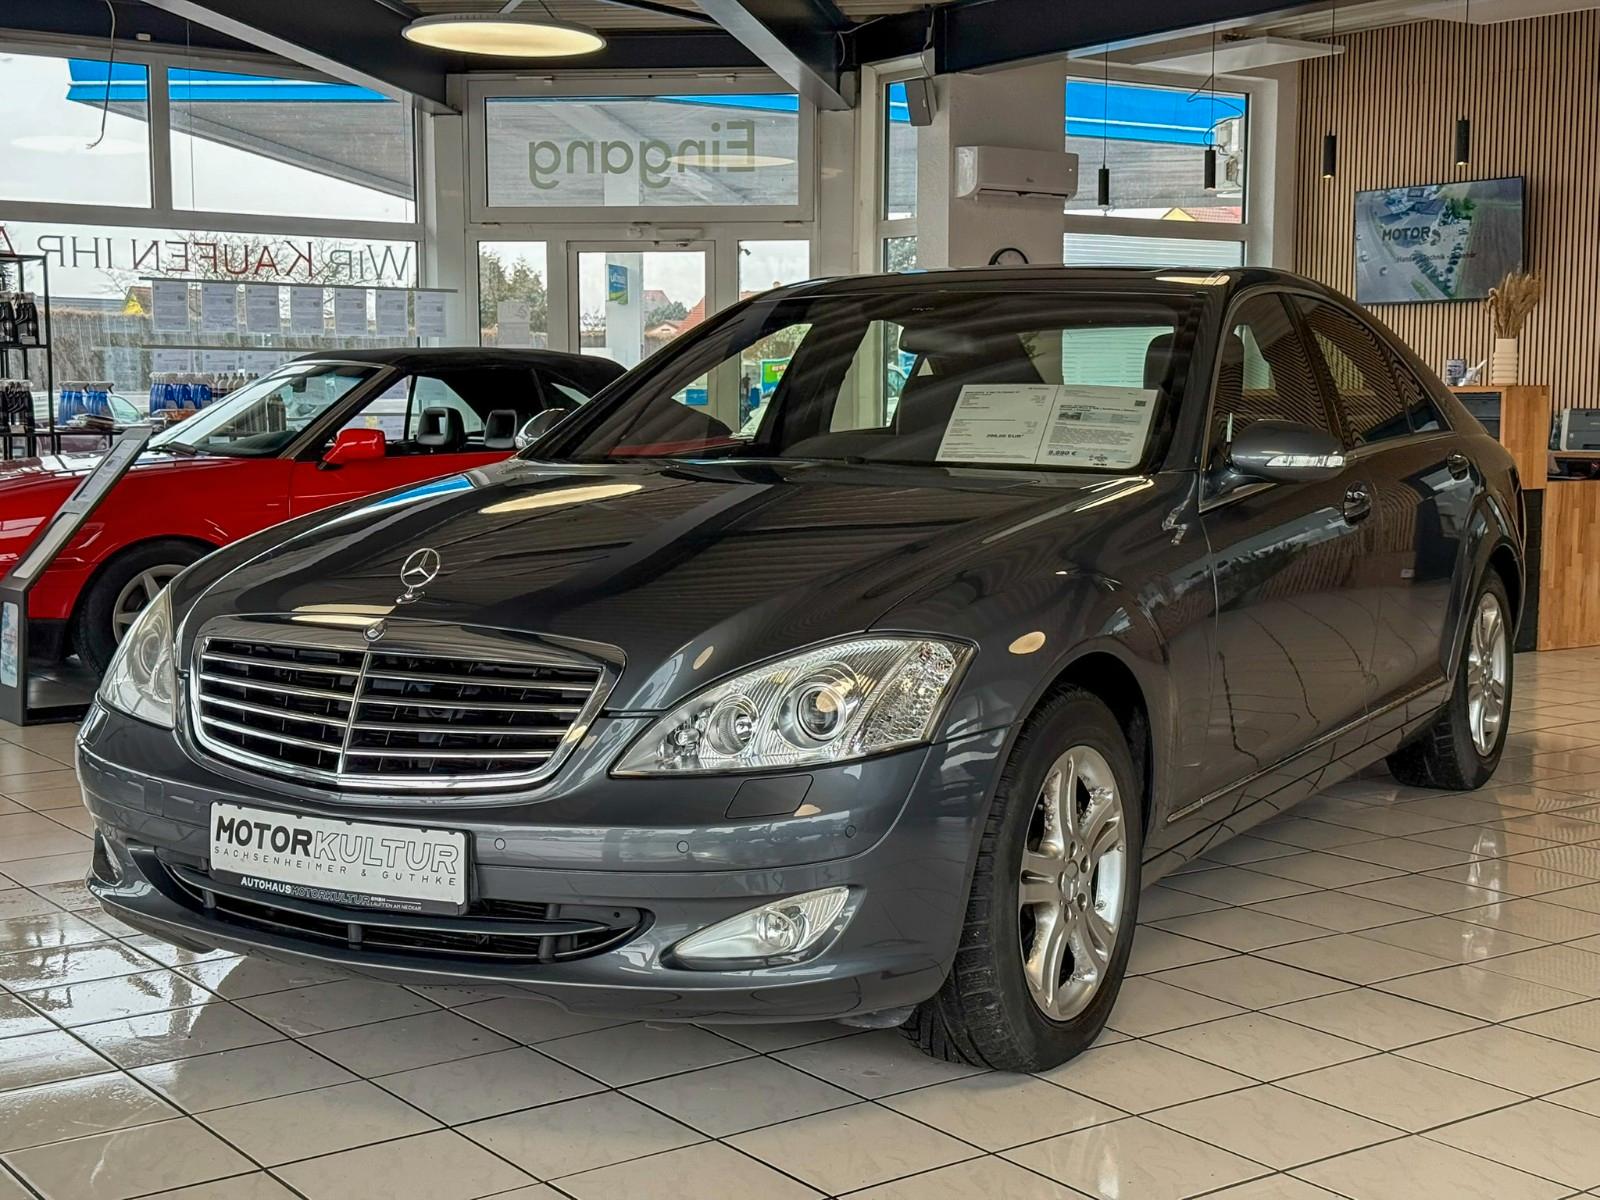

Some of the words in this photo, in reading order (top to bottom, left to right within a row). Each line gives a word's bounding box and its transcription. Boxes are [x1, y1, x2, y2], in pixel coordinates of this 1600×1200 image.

[1381, 226, 1431, 242] MOTOR
[215, 815, 459, 875] MOTORKULTUR
[214, 846, 347, 874] SACHSENHEIMER
[361, 869, 367, 877] &
[382, 871, 457, 886] GUTHKE
